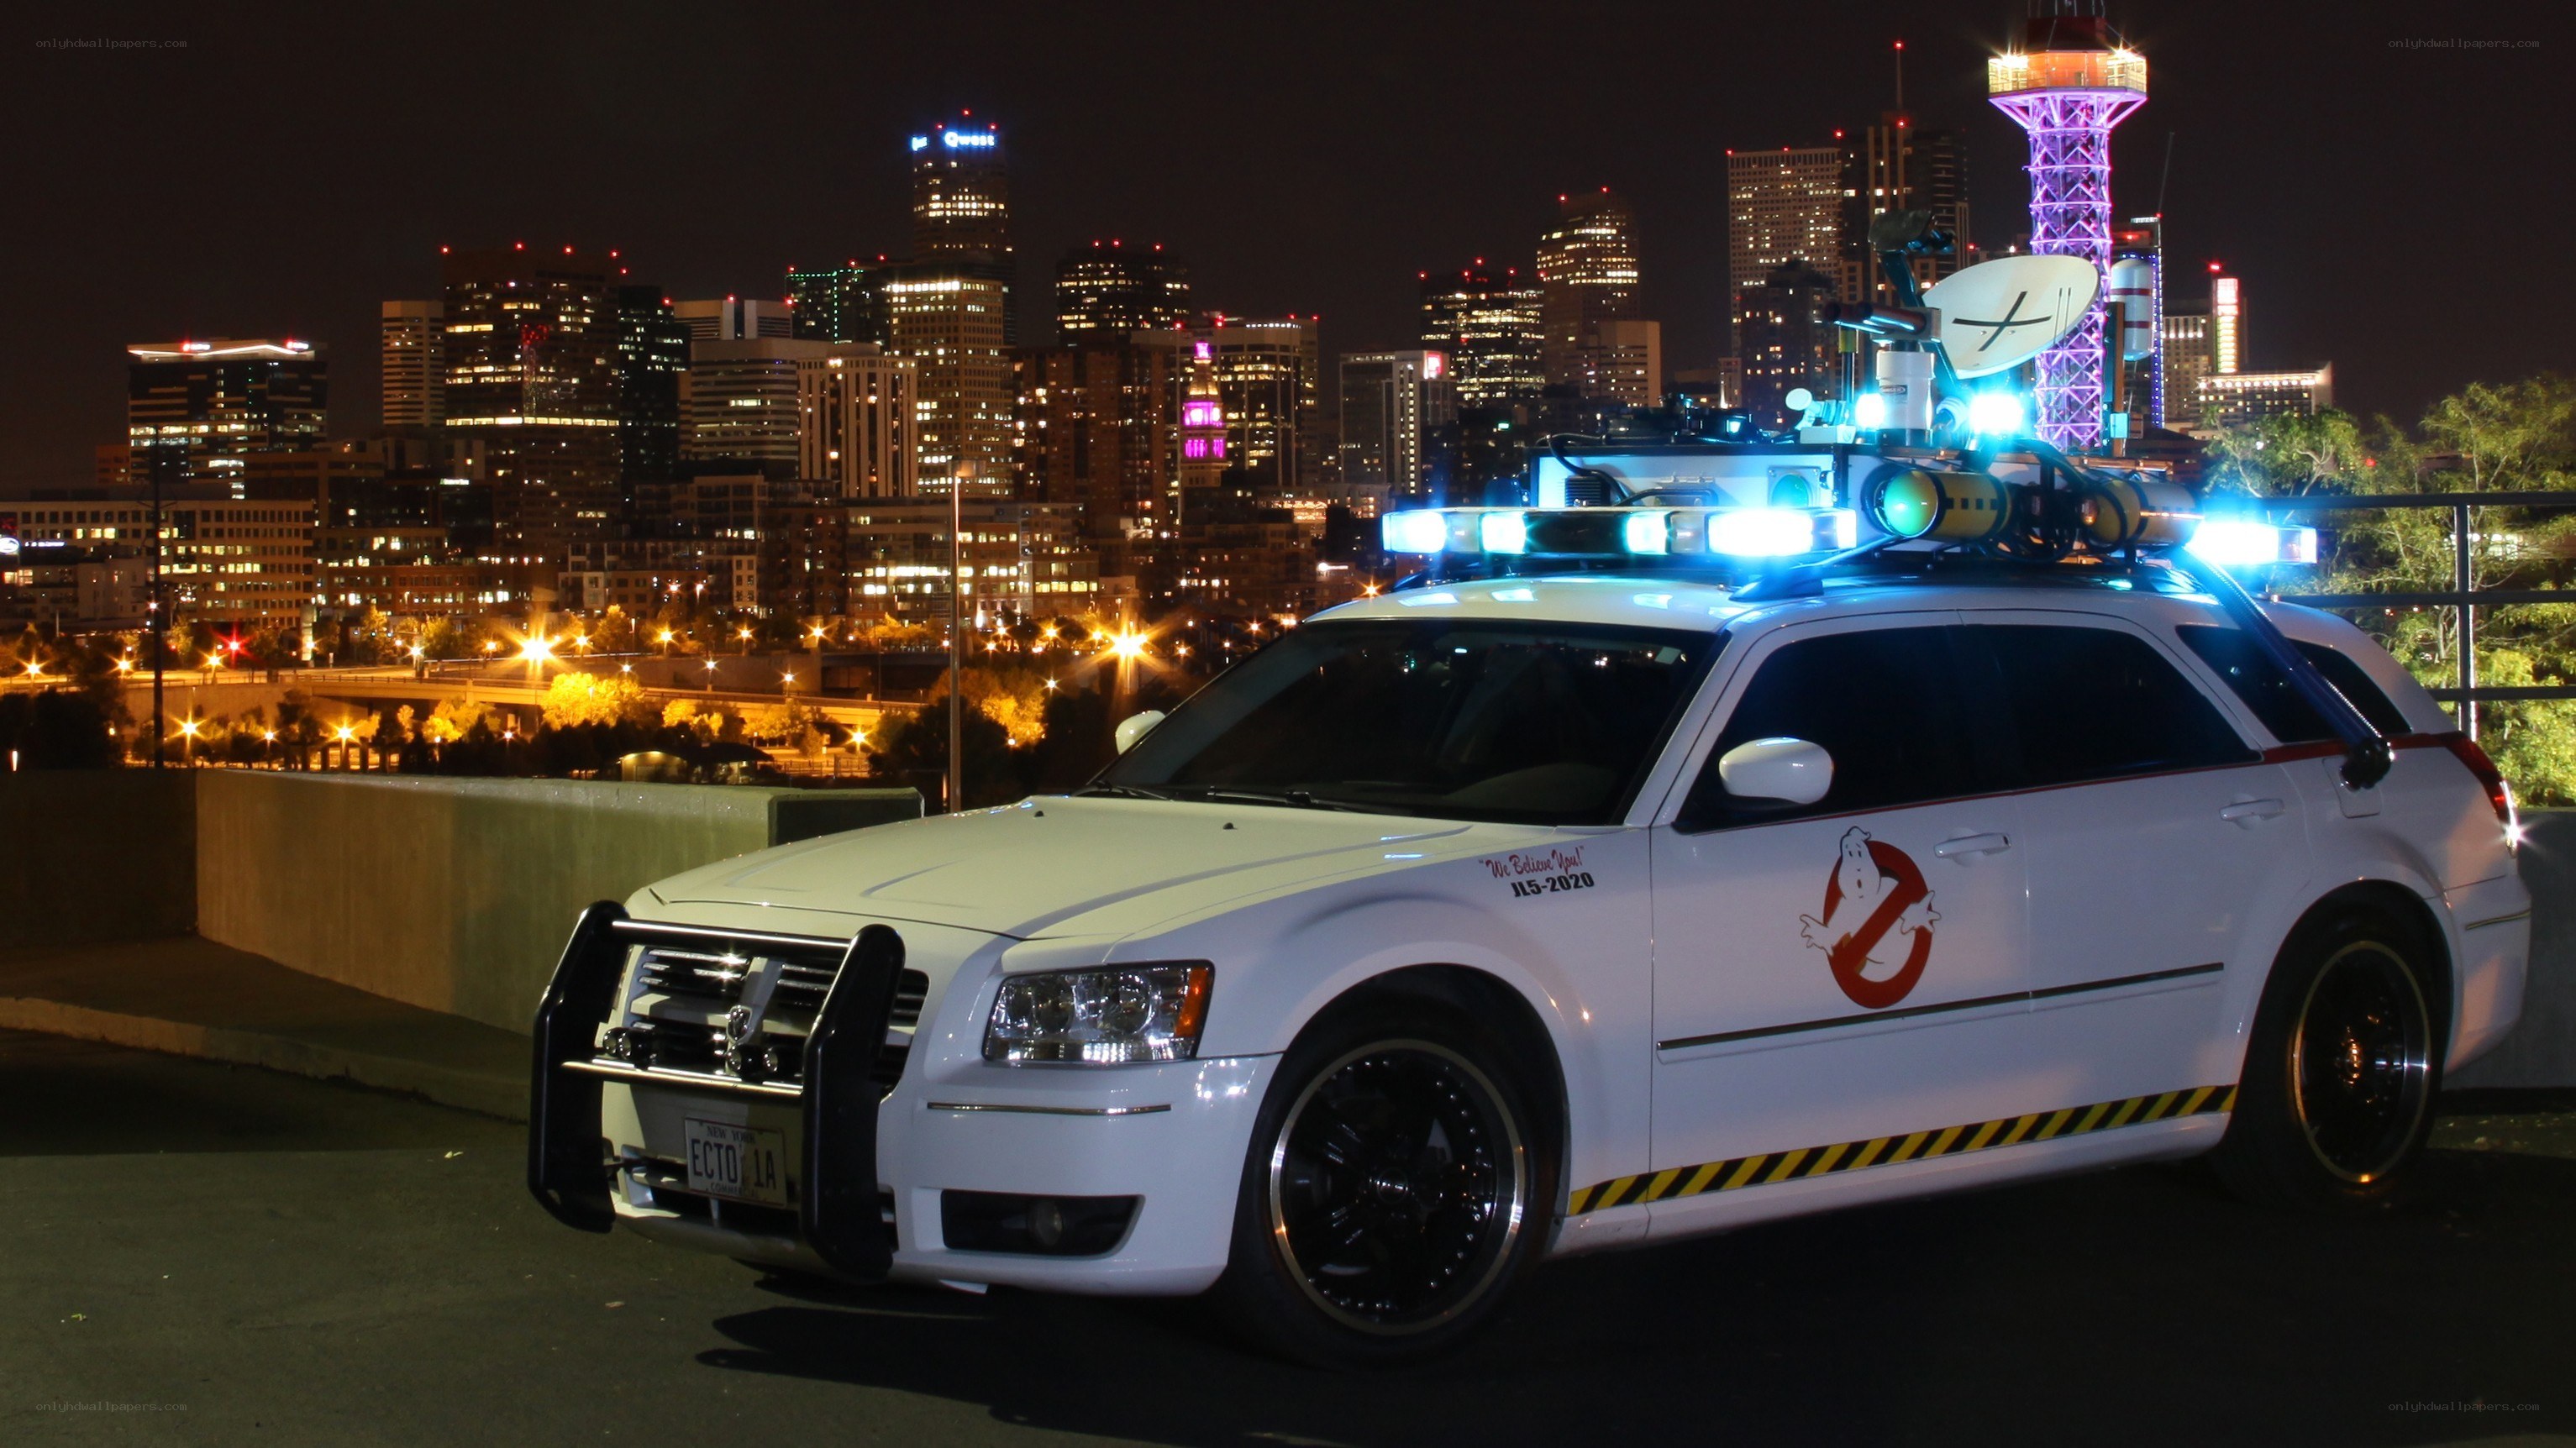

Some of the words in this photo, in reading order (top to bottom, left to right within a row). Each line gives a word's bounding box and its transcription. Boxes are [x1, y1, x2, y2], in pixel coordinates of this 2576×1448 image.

[944, 130, 995, 148] Qwest
[1508, 854, 1553, 875] Believe
[1511, 872, 1595, 898] JL5-2020
[707, 1125, 727, 1139] NEW
[731, 1130, 756, 1143] YORK
[691, 1138, 738, 1184] ECTO
[754, 1148, 777, 1190] 1A
[711, 1182, 758, 1197] COMMER
